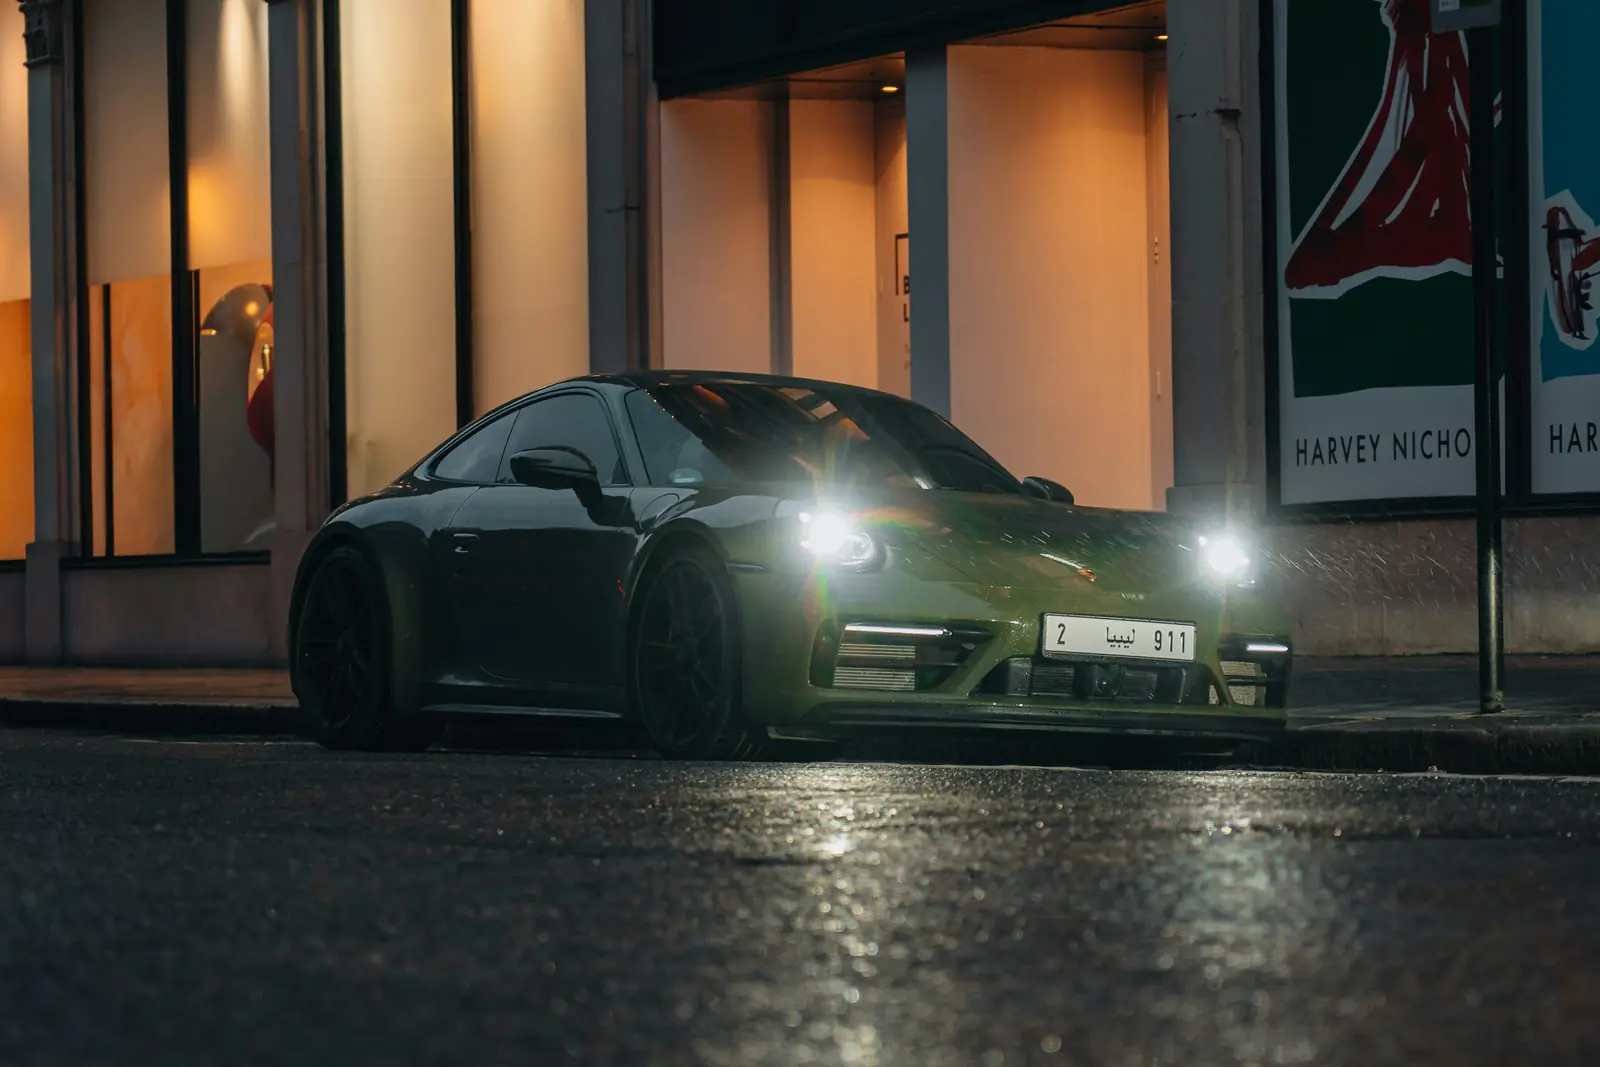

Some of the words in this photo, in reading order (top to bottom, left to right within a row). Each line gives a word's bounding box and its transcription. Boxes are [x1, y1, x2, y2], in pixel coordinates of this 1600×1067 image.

[1296, 434, 1380, 466] HARVEY
[1393, 428, 1471, 461] NICHO
[1550, 422, 1598, 453] HAR
[1056, 623, 1066, 645] 2
[1106, 626, 1136, 649] ليبيا
[1154, 630, 1186, 654] 911
